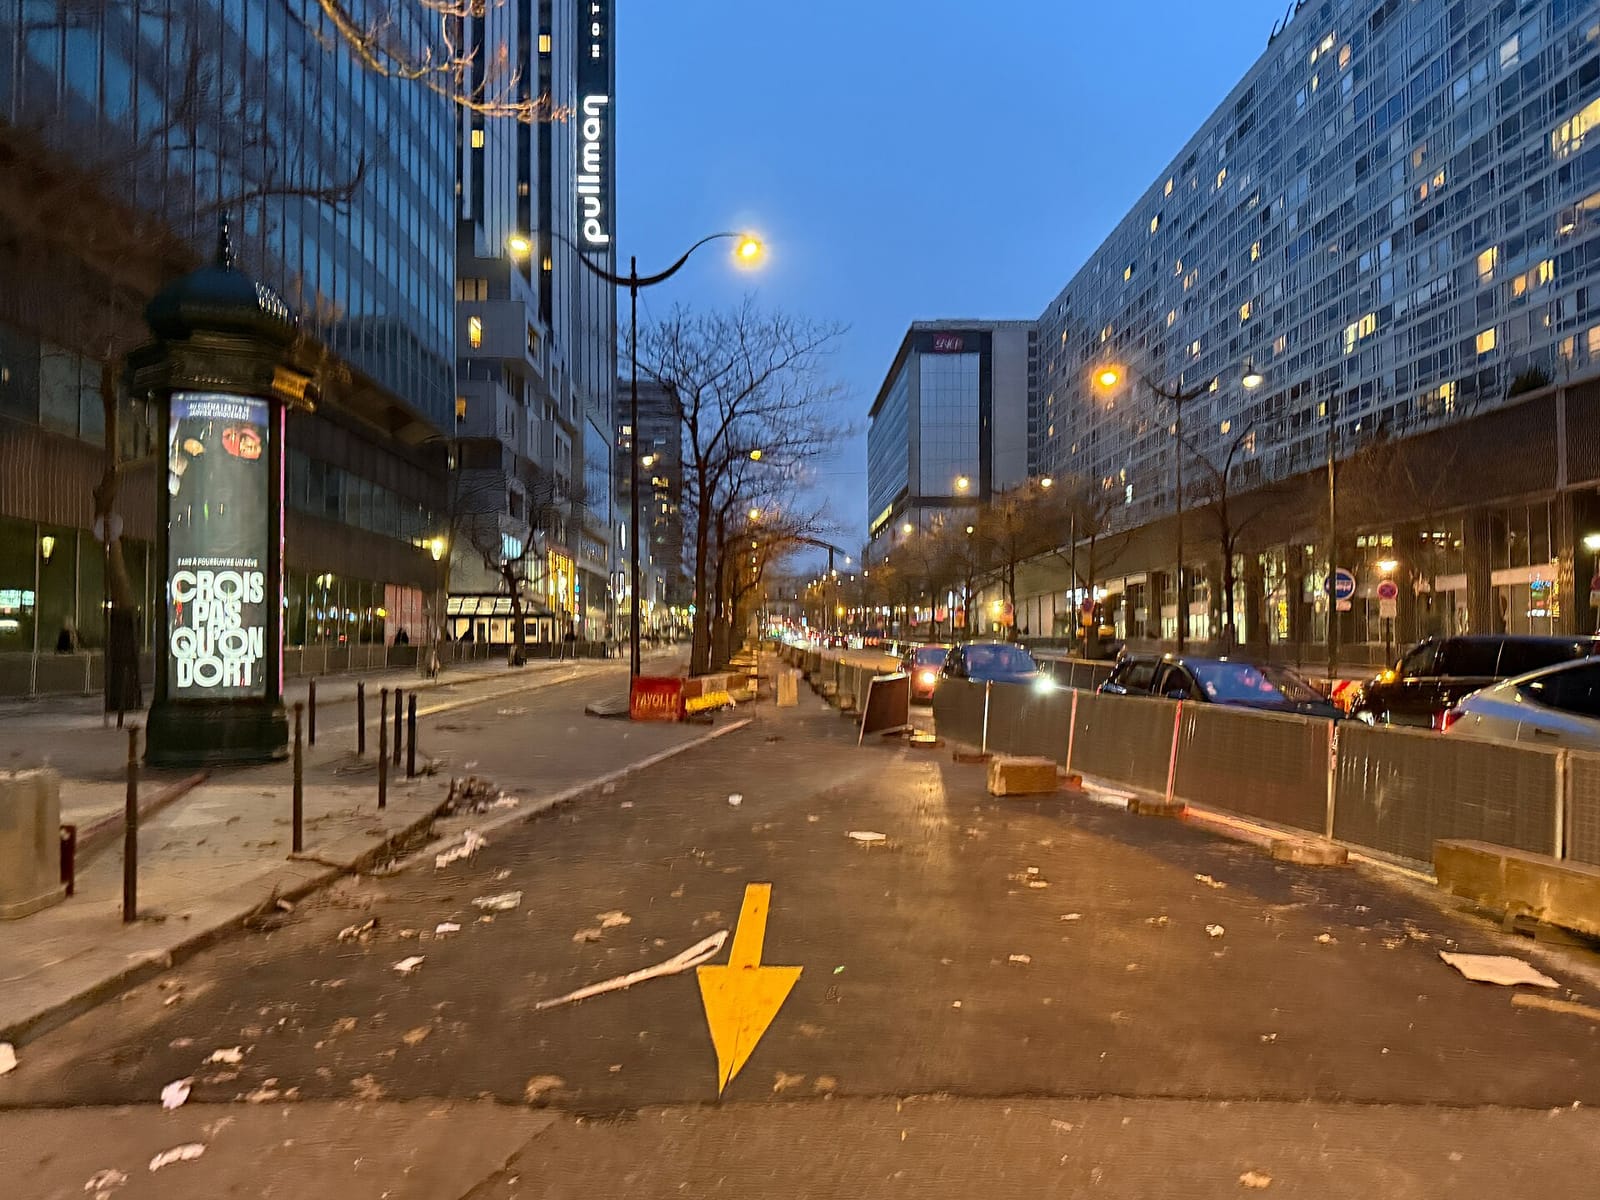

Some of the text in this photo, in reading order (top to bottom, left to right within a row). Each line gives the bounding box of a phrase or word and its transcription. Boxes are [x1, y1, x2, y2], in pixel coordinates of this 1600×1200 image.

[578, 95, 609, 243] pullman
[171, 570, 264, 604] CROIS
[192, 599, 242, 631] PAS
[177, 654, 255, 688] DORT
